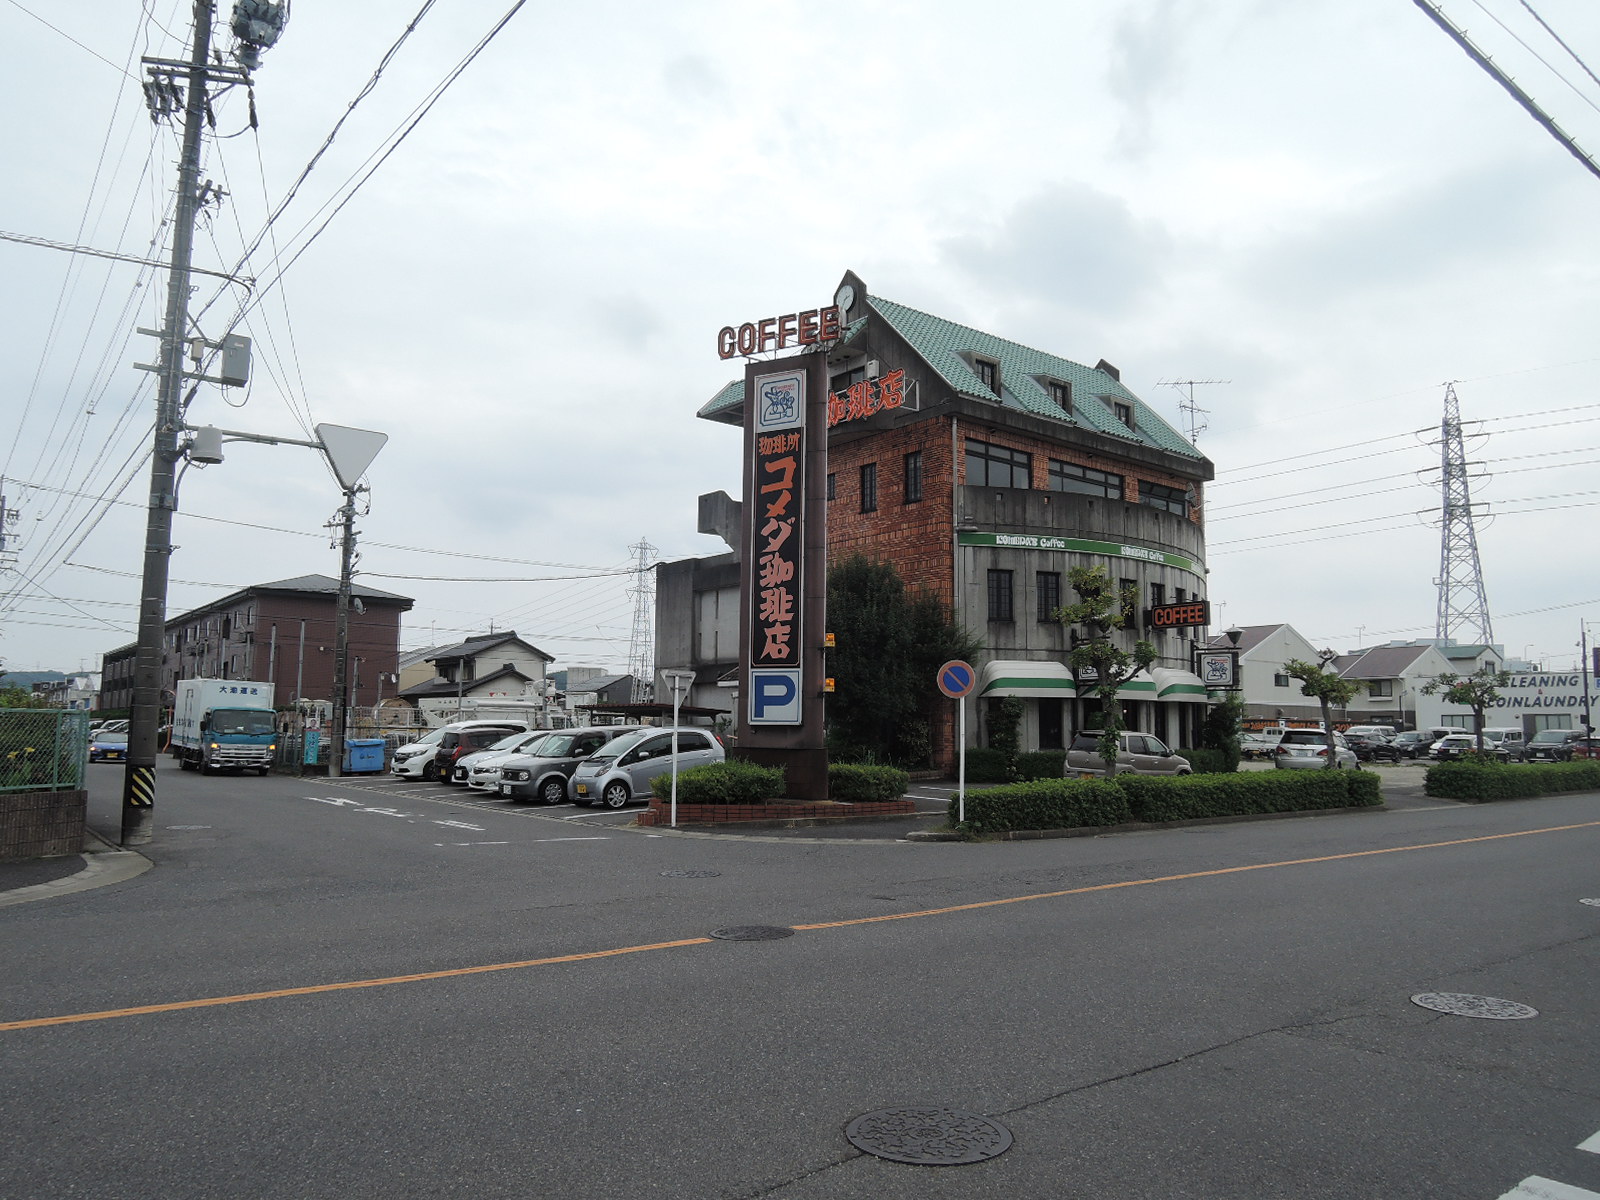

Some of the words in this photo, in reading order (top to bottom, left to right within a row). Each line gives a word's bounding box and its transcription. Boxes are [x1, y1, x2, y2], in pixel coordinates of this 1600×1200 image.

[718, 305, 841, 360] COFFEE
[758, 432, 800, 456] 珈琲所
[759, 456, 797, 660] コメダ珈琲店
[1040, 538, 1065, 548] Coffee
[1154, 605, 1203, 625] COFFEE
[754, 675, 796, 718] P
